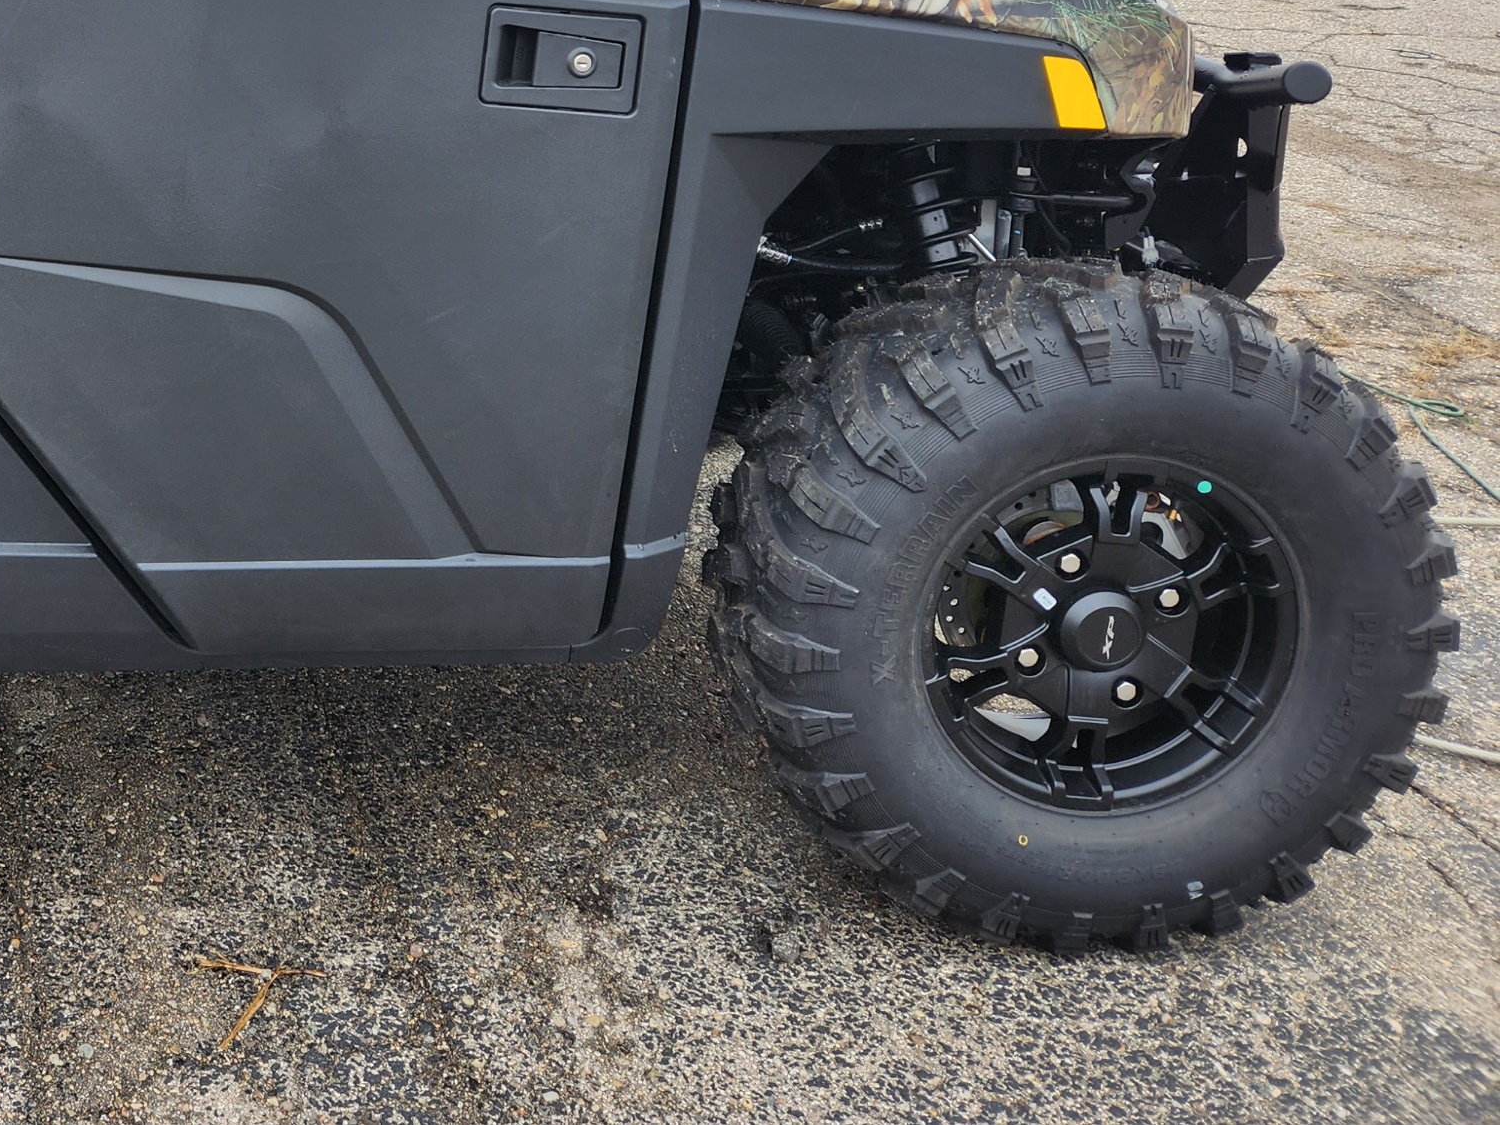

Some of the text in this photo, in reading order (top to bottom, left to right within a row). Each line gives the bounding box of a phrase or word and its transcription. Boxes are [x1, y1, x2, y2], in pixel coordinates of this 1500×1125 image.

[871, 475, 978, 687] X-TERRAIN
[1102, 616, 1115, 660] XP
[1285, 611, 1380, 798] PRO ARMOR
